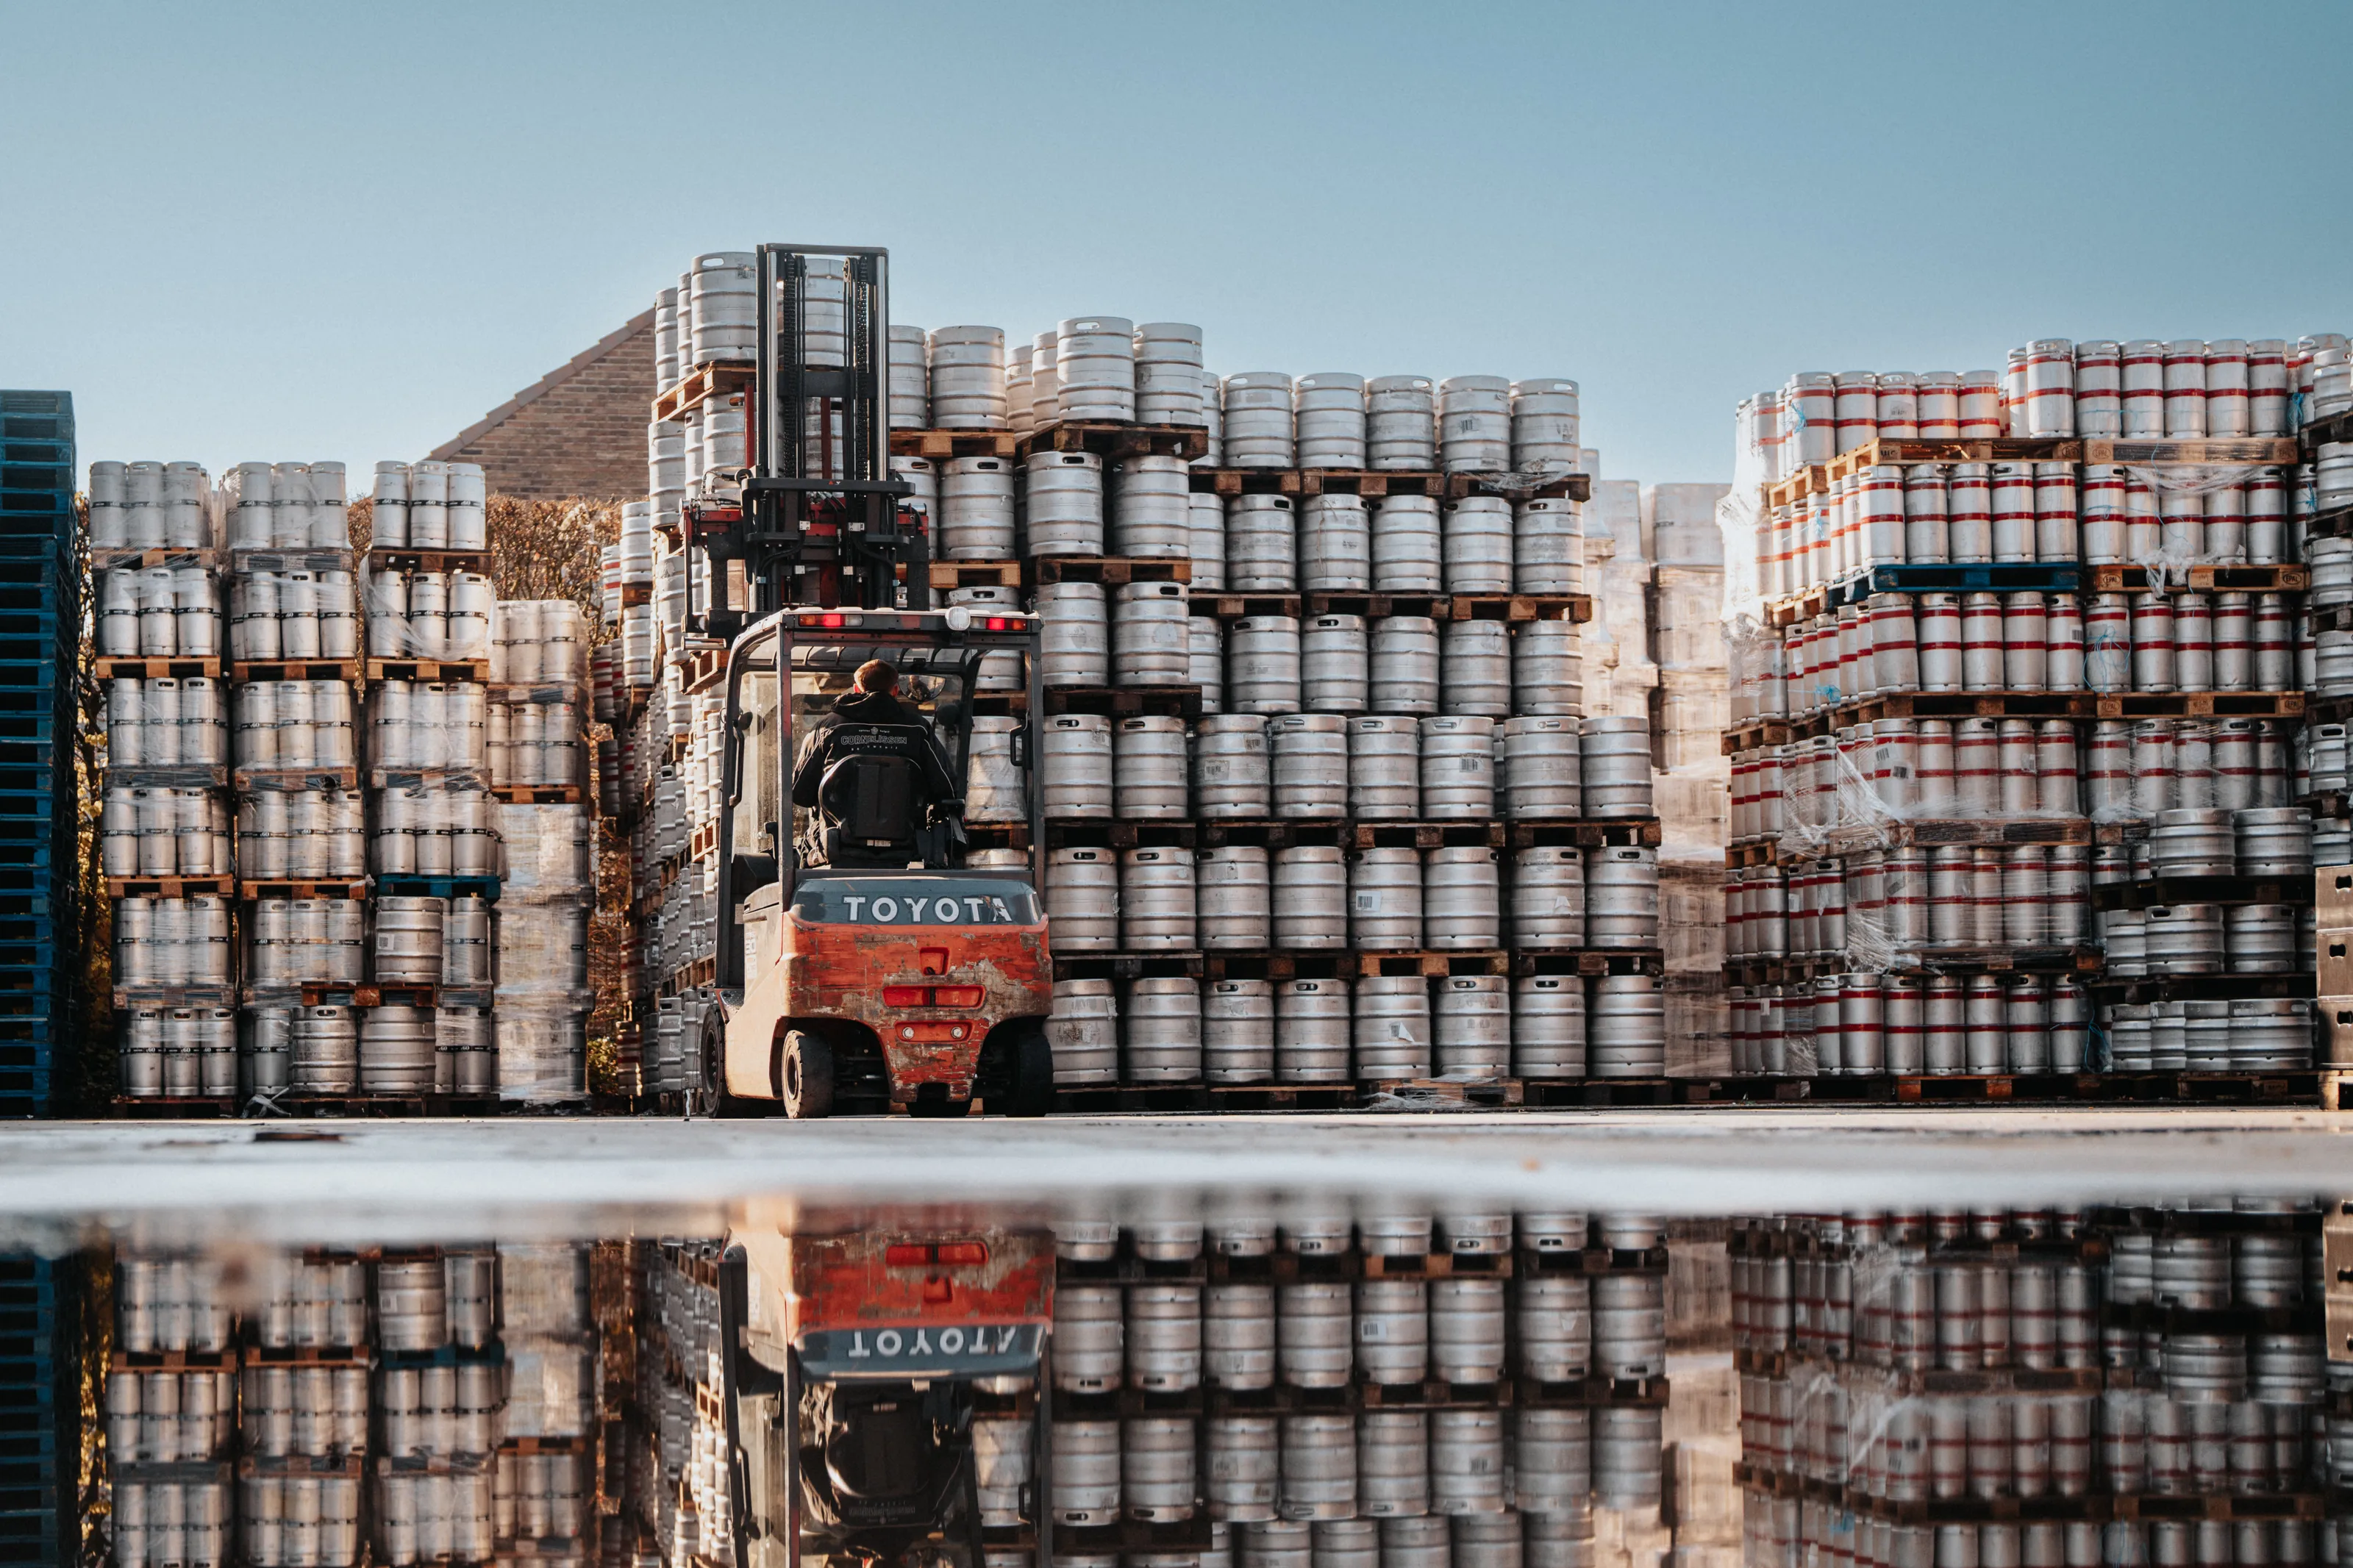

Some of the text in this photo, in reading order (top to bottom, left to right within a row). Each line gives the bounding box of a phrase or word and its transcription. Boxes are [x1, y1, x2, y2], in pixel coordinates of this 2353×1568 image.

[2285, 574, 2299, 582] EPAL
[840, 735, 907, 745] CORNELISSEN
[843, 896, 1013, 923] TOYOTA
